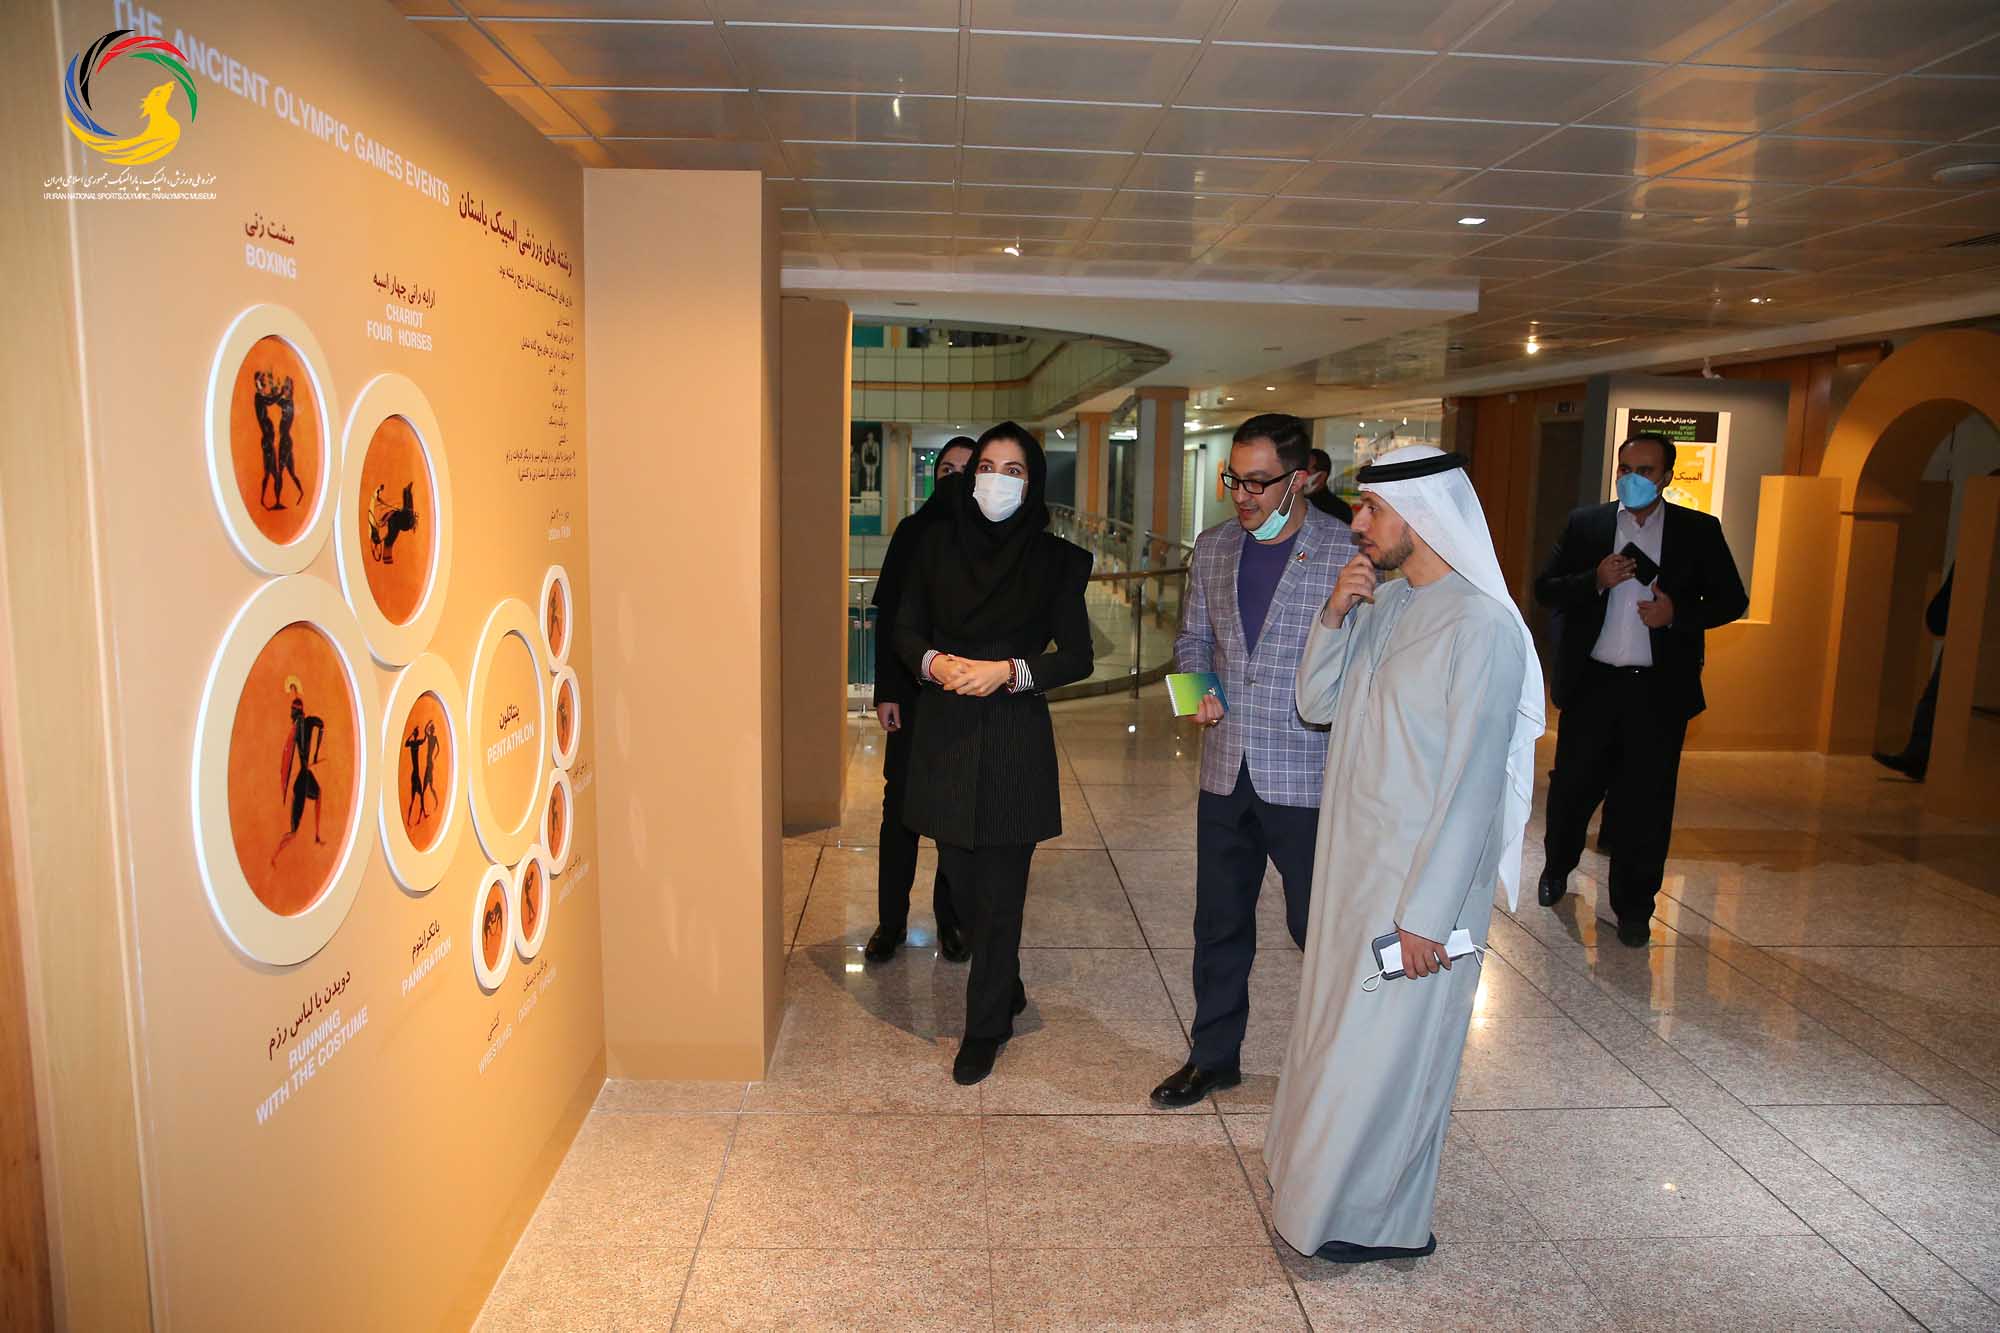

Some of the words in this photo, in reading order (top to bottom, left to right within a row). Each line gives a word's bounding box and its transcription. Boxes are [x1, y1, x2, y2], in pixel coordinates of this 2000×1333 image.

[171, 28, 269, 109] ANCIENT
[274, 84, 350, 153] OLYMPIC
[354, 131, 403, 181] GAMES
[406, 160, 450, 208] EVENTS
[245, 212, 264, 238] زنی
[459, 191, 488, 236] باستان
[490, 210, 518, 248] المپیک
[267, 221, 295, 246] مشت
[519, 228, 543, 263] ورزشی
[245, 243, 297, 280] BOXING
[558, 250, 573, 278] رشته
[390, 275, 407, 302] چهار
[408, 282, 421, 304] رانی
[422, 287, 436, 309] ارابه
[385, 303, 424, 329] CHARIOT
[367, 320, 393, 343] FOUR
[399, 328, 433, 352] HORSES
[1674, 471, 1702, 484] المپیک
[487, 720, 535, 767] PENTATHLON
[401, 935, 452, 997] PANKRATION
[315, 991, 322, 1013] با
[325, 970, 351, 1004] دویدن
[290, 995, 313, 1038] لباس
[269, 1026, 288, 1061] رزم
[288, 1007, 341, 1070] RUNNING
[256, 1080, 289, 1126] WITH
[292, 1056, 315, 1092] THE
[317, 1004, 369, 1068] COSTUME
